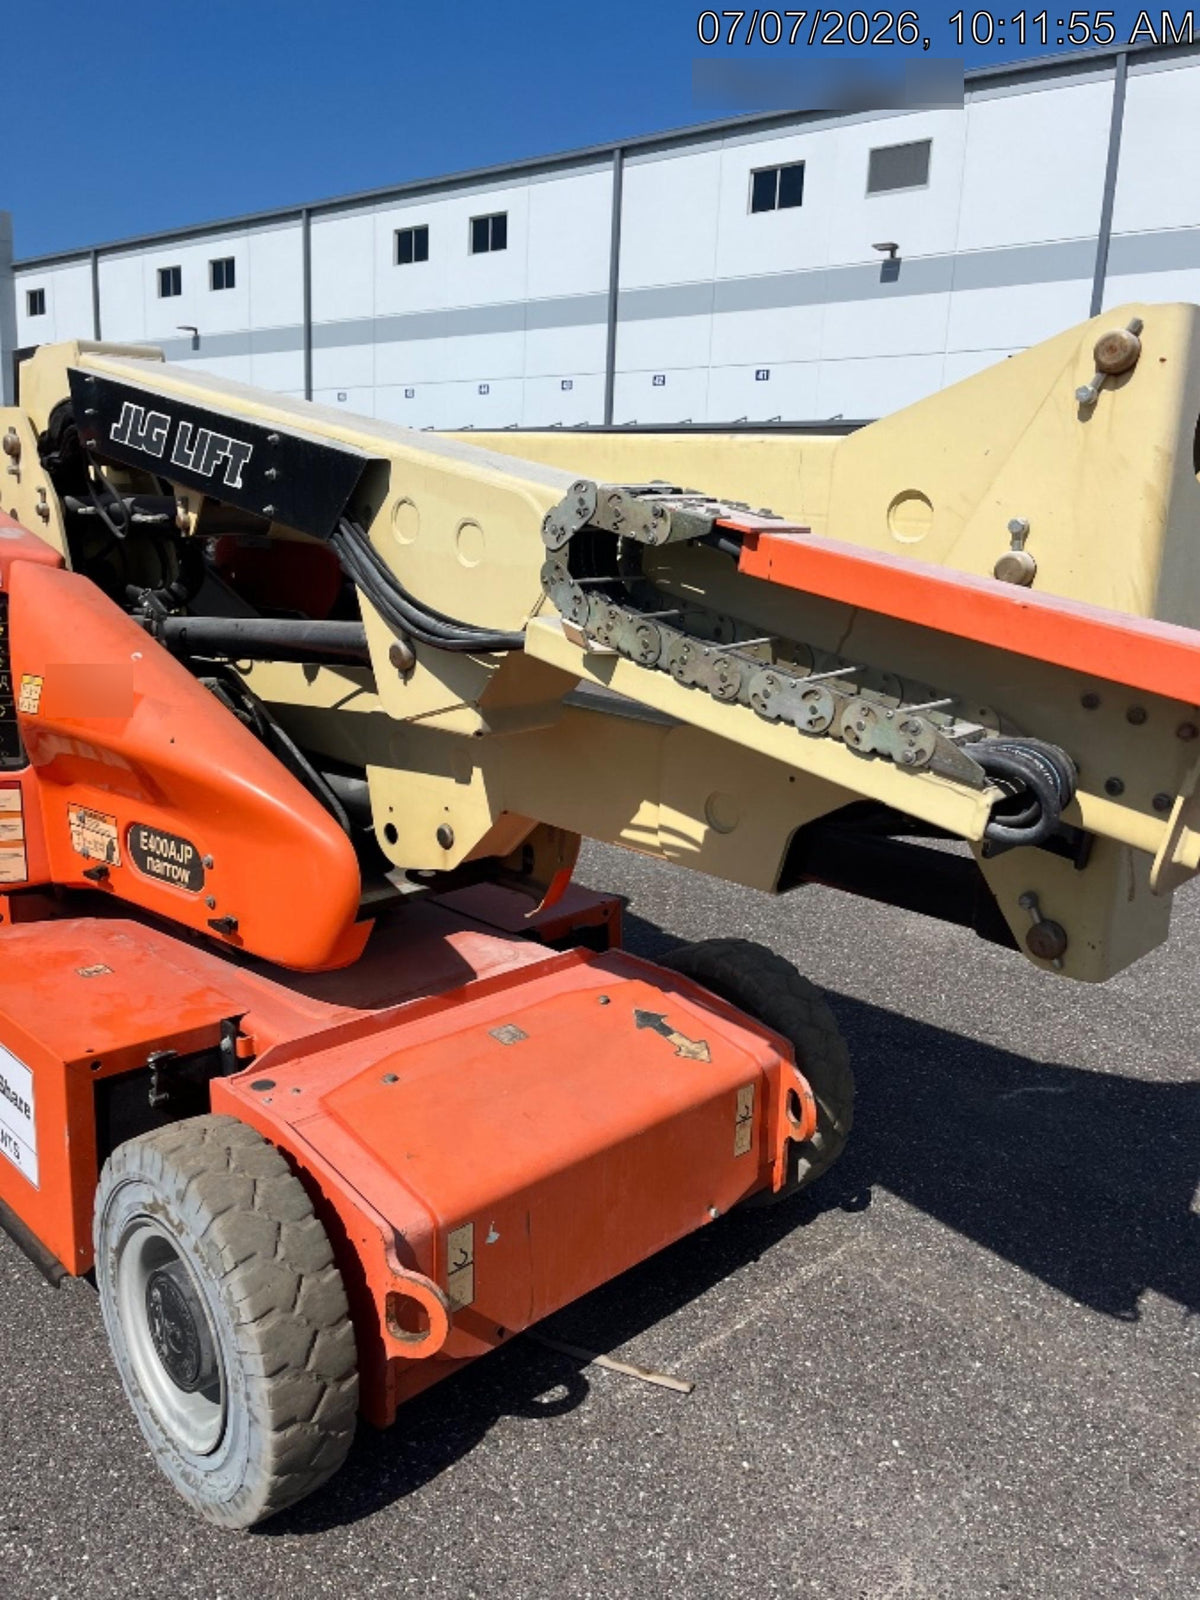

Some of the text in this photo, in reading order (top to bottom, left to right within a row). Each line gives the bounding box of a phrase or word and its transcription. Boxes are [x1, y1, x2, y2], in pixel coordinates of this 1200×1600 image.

[110, 401, 253, 489] JLG LIFT
[140, 831, 193, 864] E400AJP
[146, 856, 190, 883] narrow
